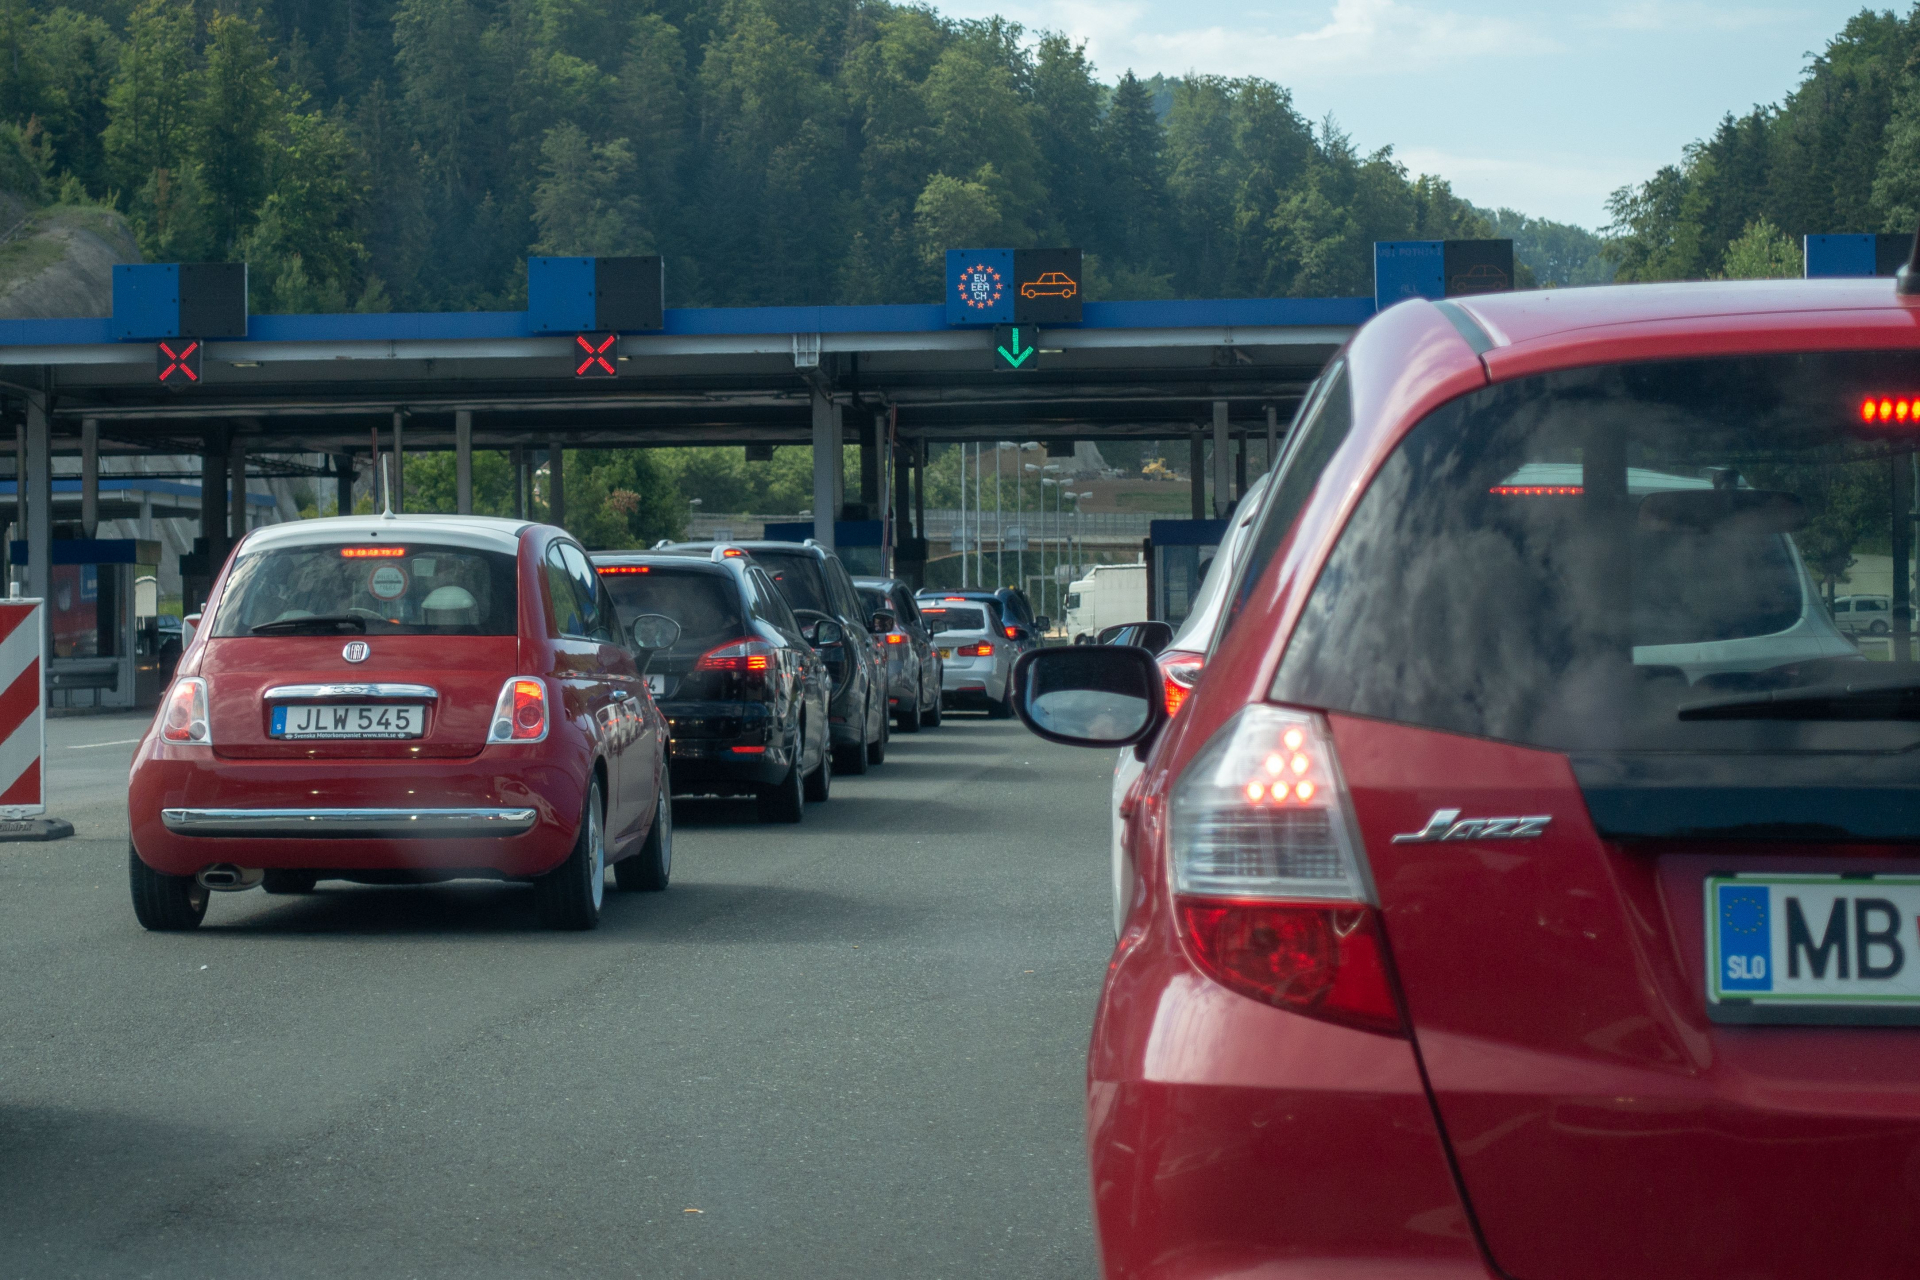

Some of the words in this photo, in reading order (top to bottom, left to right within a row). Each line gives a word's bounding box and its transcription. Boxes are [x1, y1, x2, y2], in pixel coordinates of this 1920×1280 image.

[971, 282, 990, 291] EEA
[974, 273, 987, 282] EU
[974, 291, 987, 300] CH
[297, 708, 349, 731] JLW
[357, 708, 410, 731] 545
[1391, 808, 1552, 844] Jazz
[1785, 897, 1906, 980] MB
[1727, 955, 1766, 980] SLO
